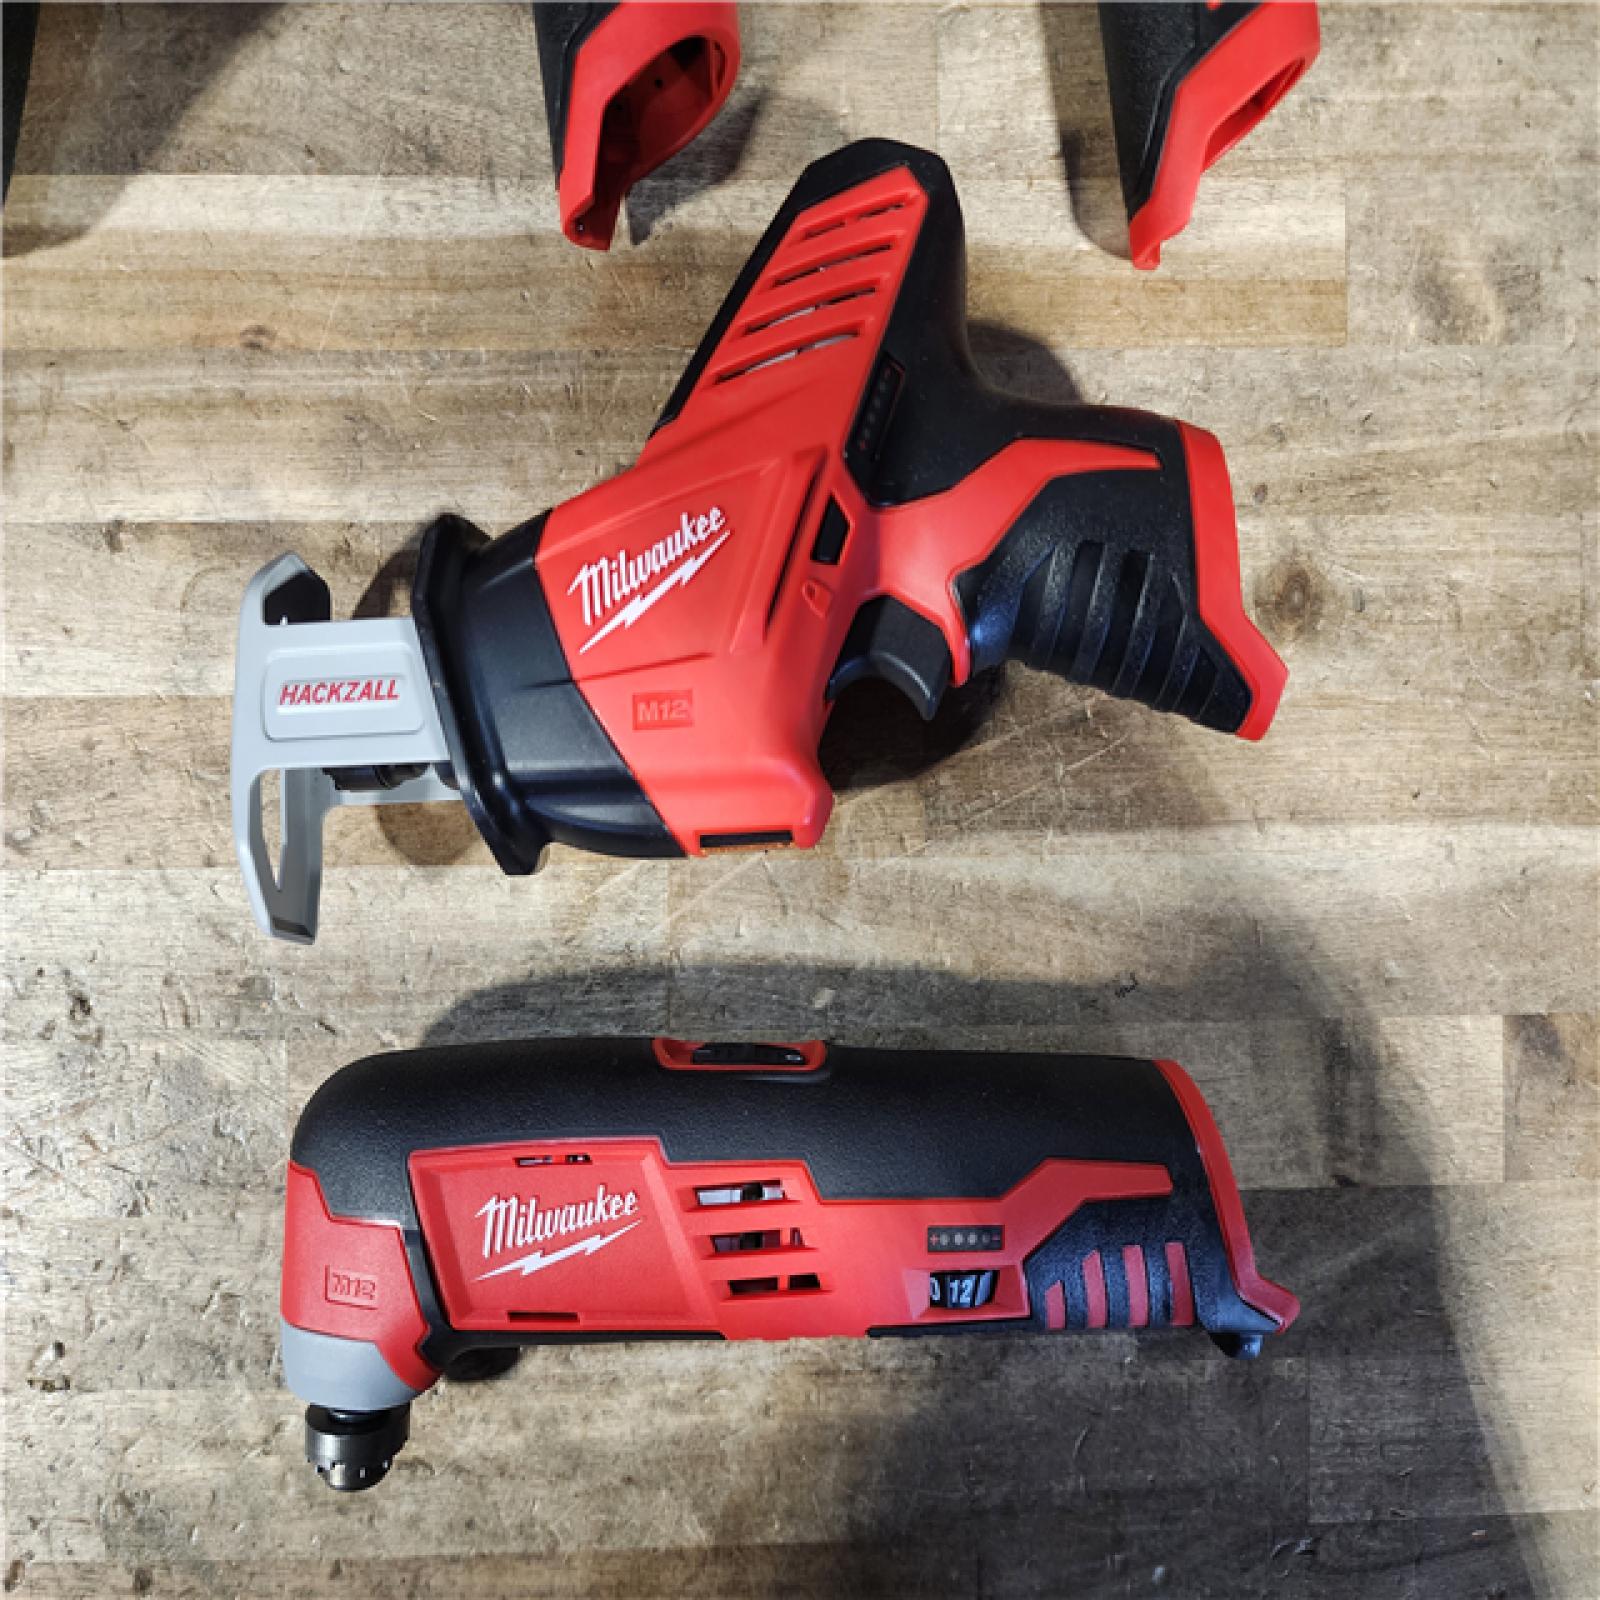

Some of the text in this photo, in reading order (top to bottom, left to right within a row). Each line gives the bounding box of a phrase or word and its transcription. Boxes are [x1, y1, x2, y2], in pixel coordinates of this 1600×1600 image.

[567, 506, 726, 625] Milwaukee
[279, 679, 400, 706] HACKZALL
[635, 701, 691, 723] M12
[475, 1185, 639, 1258] Milwaukee
[332, 1272, 376, 1301] M12
